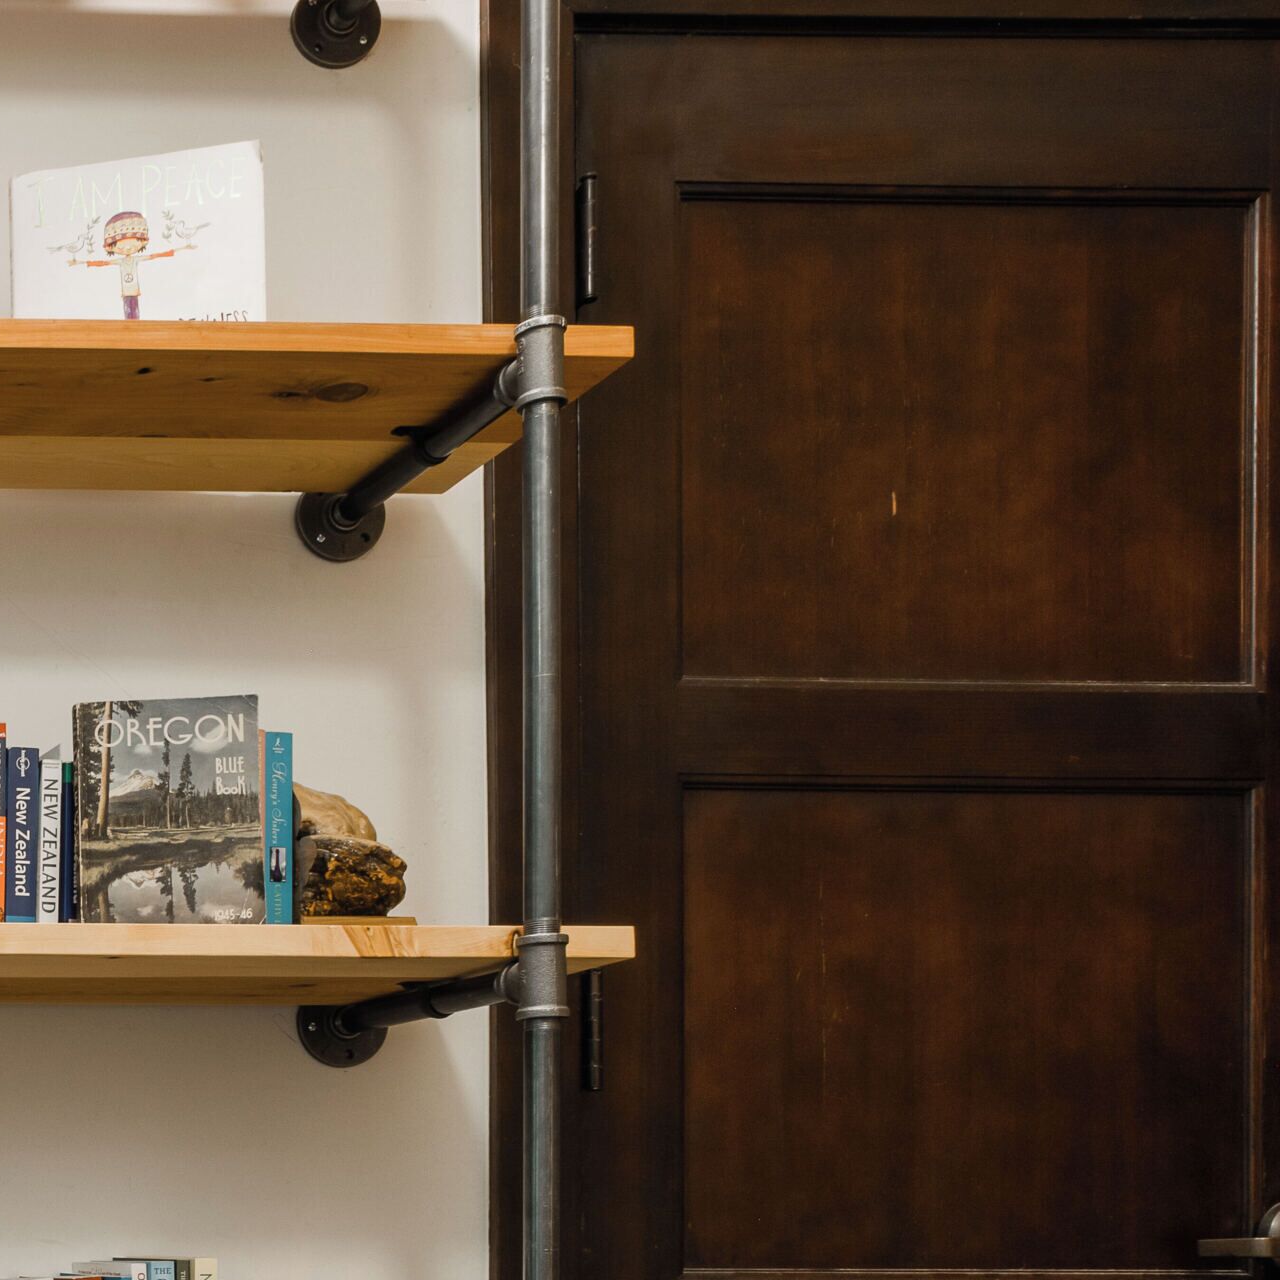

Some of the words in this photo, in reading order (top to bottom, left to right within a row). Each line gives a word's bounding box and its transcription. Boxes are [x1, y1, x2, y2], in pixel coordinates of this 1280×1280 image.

[70, 173, 124, 222] AM
[139, 157, 247, 217] PEACE
[95, 713, 245, 747] OREGON
[215, 757, 245, 775] BLUE
[15, 787, 30, 826] New
[43, 778, 58, 820] NEW
[15, 829, 30, 897] Zealand
[42, 827, 58, 914] ZEALAND
[214, 908, 253, 921] 1945-46
